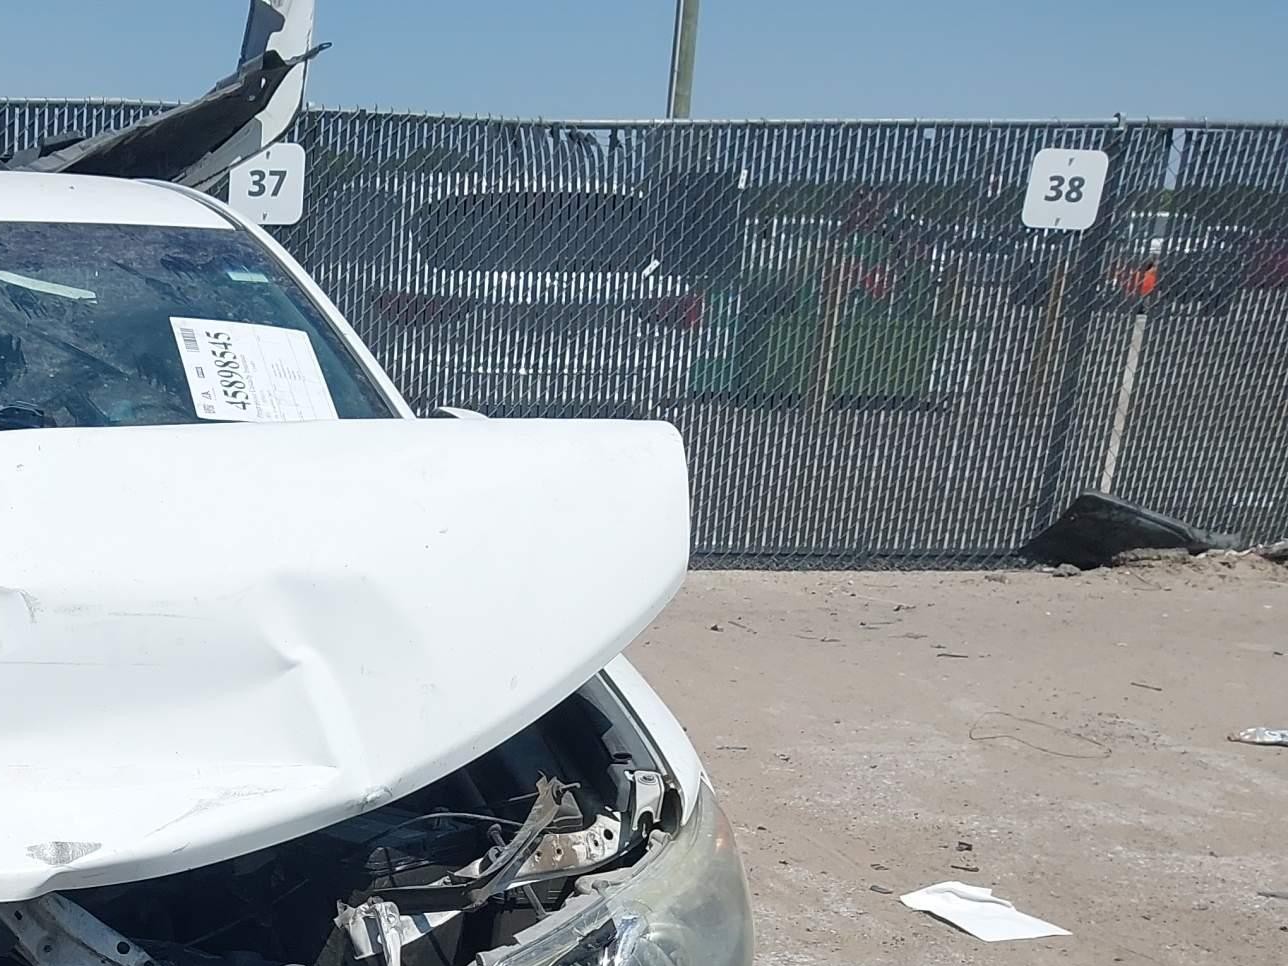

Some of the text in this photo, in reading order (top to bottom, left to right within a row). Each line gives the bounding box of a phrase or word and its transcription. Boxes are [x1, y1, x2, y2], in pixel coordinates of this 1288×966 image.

[247, 169, 287, 197] 37
[1043, 175, 1085, 203] 38
[205, 331, 251, 410] 45898545
